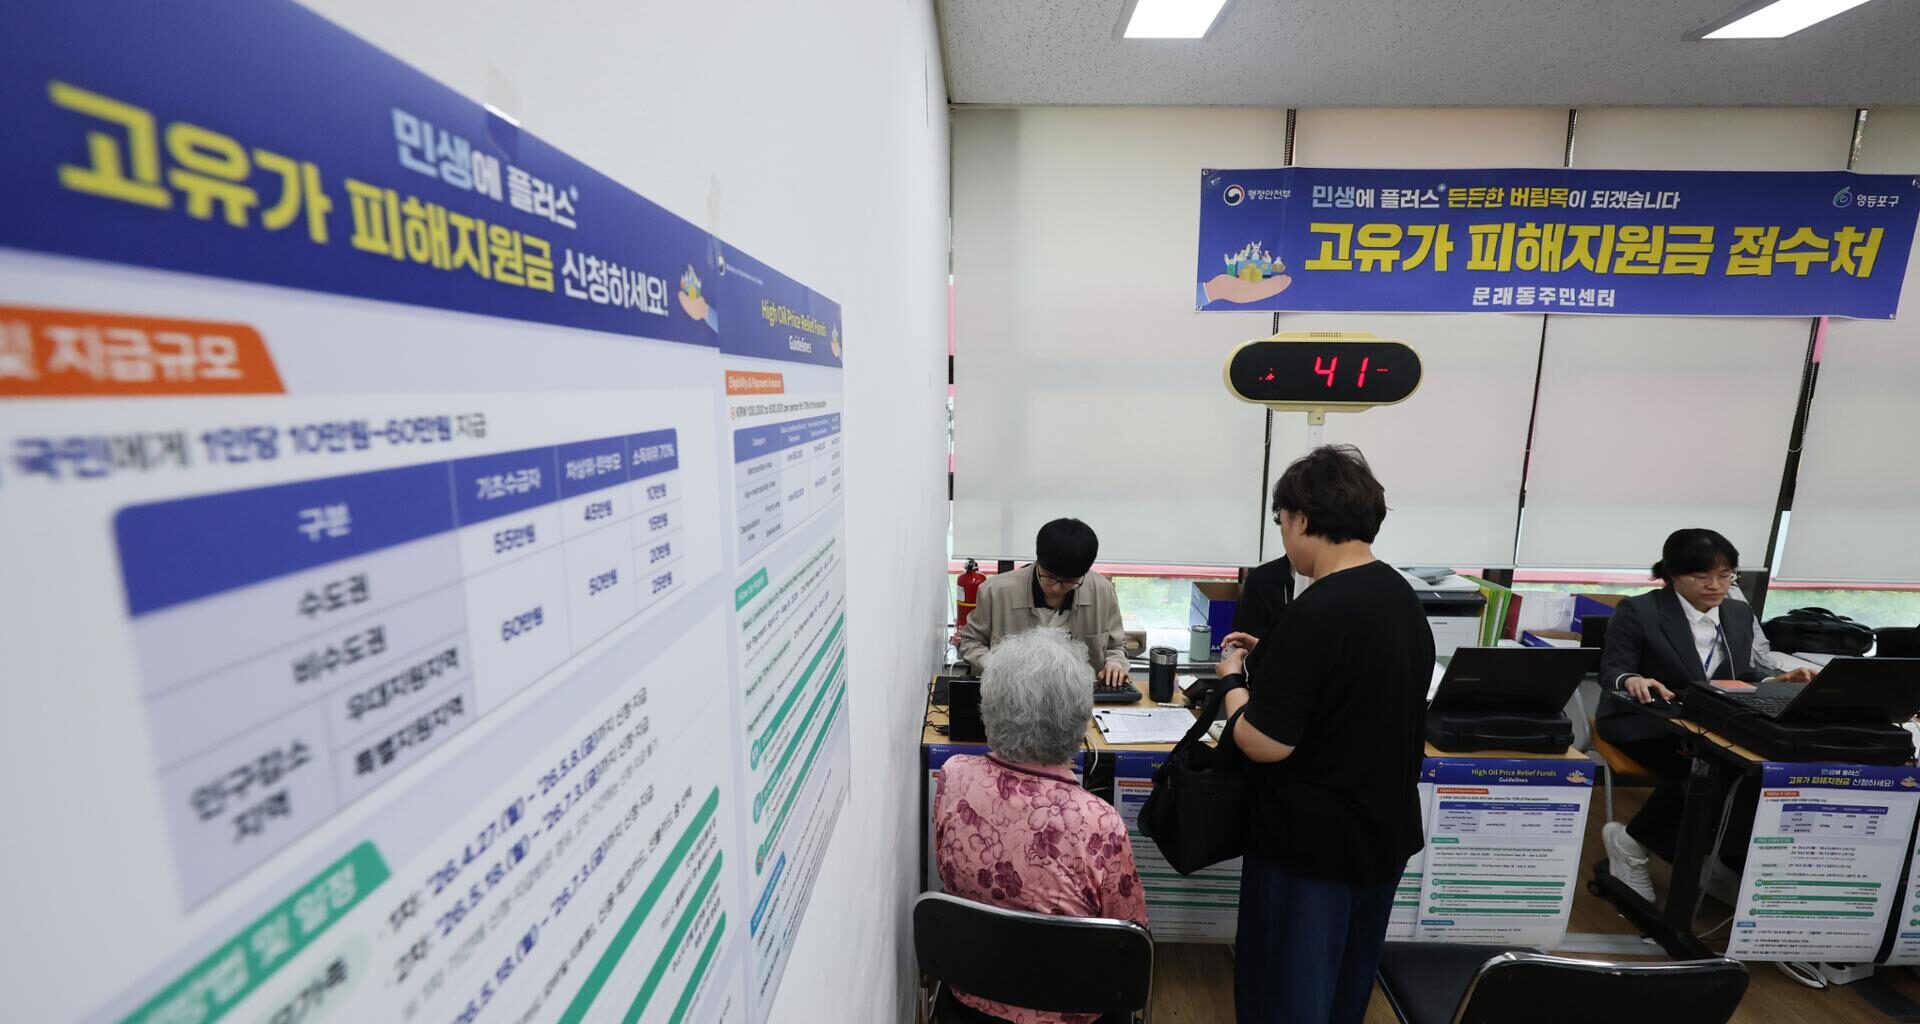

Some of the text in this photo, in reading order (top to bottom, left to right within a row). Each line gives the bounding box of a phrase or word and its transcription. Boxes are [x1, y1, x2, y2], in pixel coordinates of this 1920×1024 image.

[392, 108, 503, 201] 민생에
[47, 80, 669, 316] 고유가 피해지원금 신청하세요!
[1248, 189, 1291, 200] 행정안전부
[1312, 185, 1374, 208] 민생에
[1447, 187, 1504, 209] 든든한
[1510, 187, 1586, 209] 버팀목이
[1590, 190, 1680, 210] 되겠습니다
[1856, 194, 1900, 208] 영등포구
[1304, 222, 1886, 278] 고유가 피해지원금 접수처
[1472, 286, 1616, 307] 문래동주민센터
[43, 324, 244, 382] 지급규모
[201, 425, 279, 463] 1인당
[456, 412, 487, 438] 지급
[298, 503, 352, 542] 구분
[494, 524, 536, 554] 55만원
[299, 573, 369, 617] 수도권
[293, 625, 388, 684] 비수도권
[1472, 768, 1487, 777] High
[1488, 768, 1498, 776] Oil
[1499, 768, 1516, 776] Price
[1517, 768, 1536, 777] Relief
[1788, 776, 1895, 787] 고유가 피해지원금 신청하세요!
